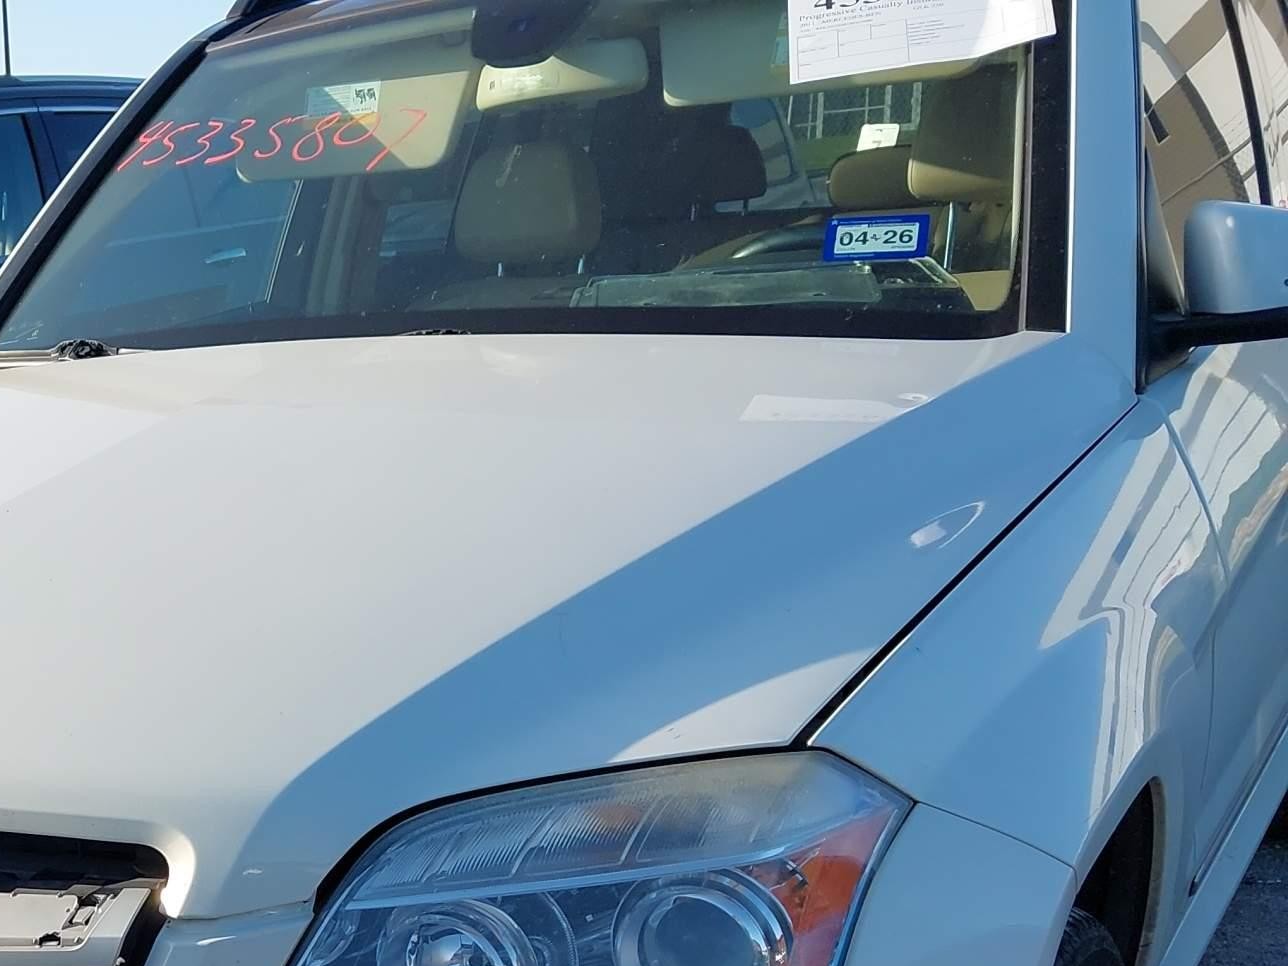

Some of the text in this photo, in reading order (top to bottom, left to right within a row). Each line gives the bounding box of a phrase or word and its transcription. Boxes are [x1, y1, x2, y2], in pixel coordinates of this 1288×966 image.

[117, 108, 428, 171] 45335807
[839, 229, 914, 246] 04 26
